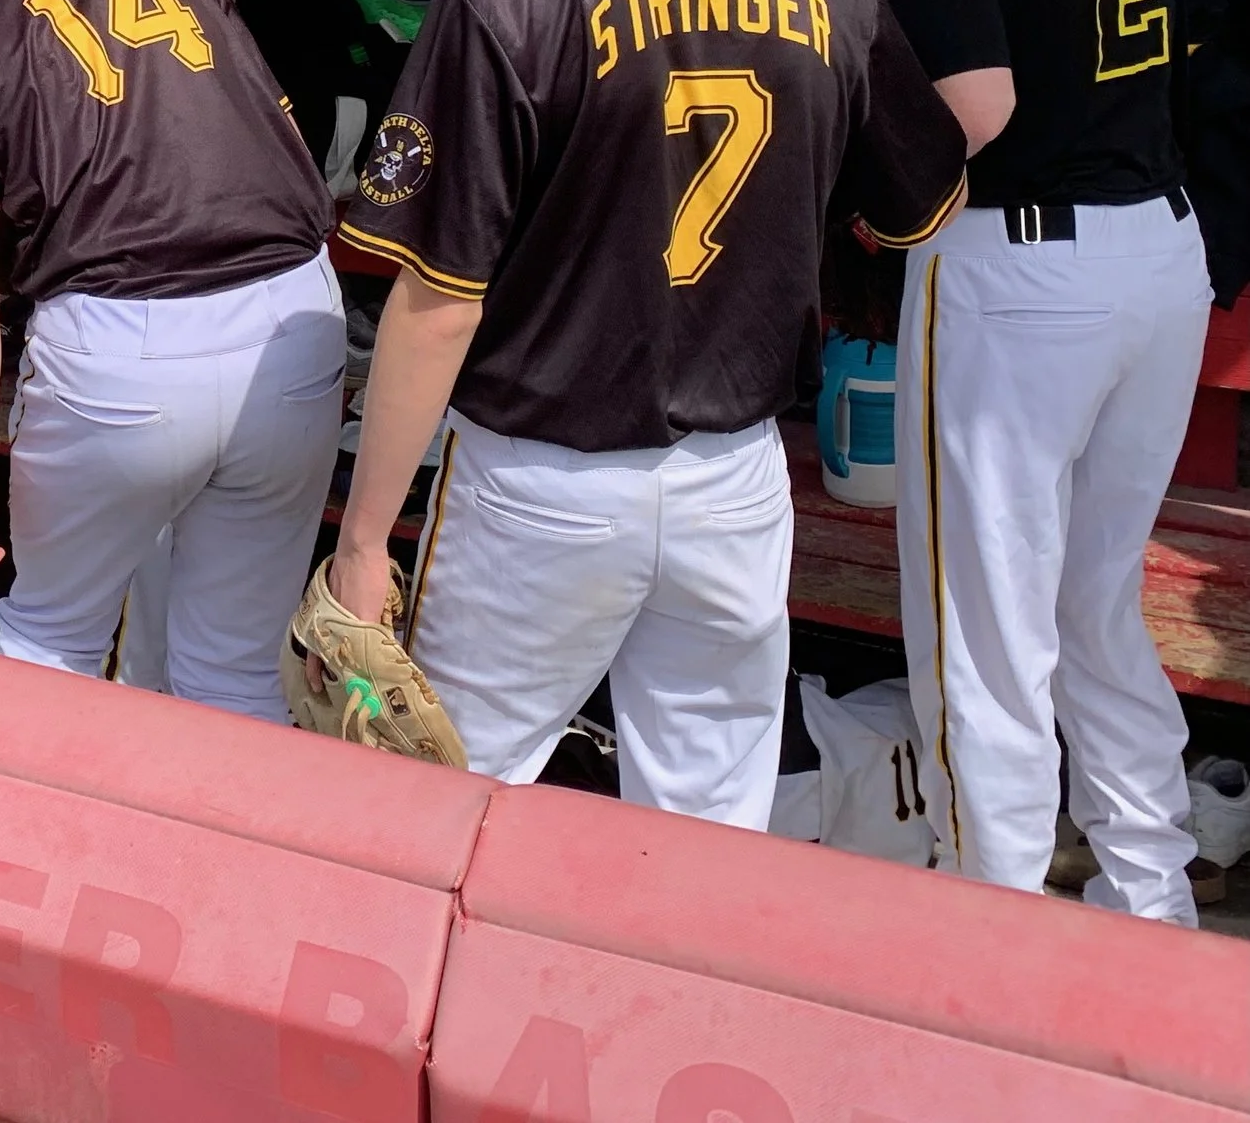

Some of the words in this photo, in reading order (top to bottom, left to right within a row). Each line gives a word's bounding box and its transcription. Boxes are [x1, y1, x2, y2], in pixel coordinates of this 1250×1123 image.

[409, 122, 432, 167] DELTA
[662, 69, 773, 288] 7
[890, 738, 927, 822] 11
